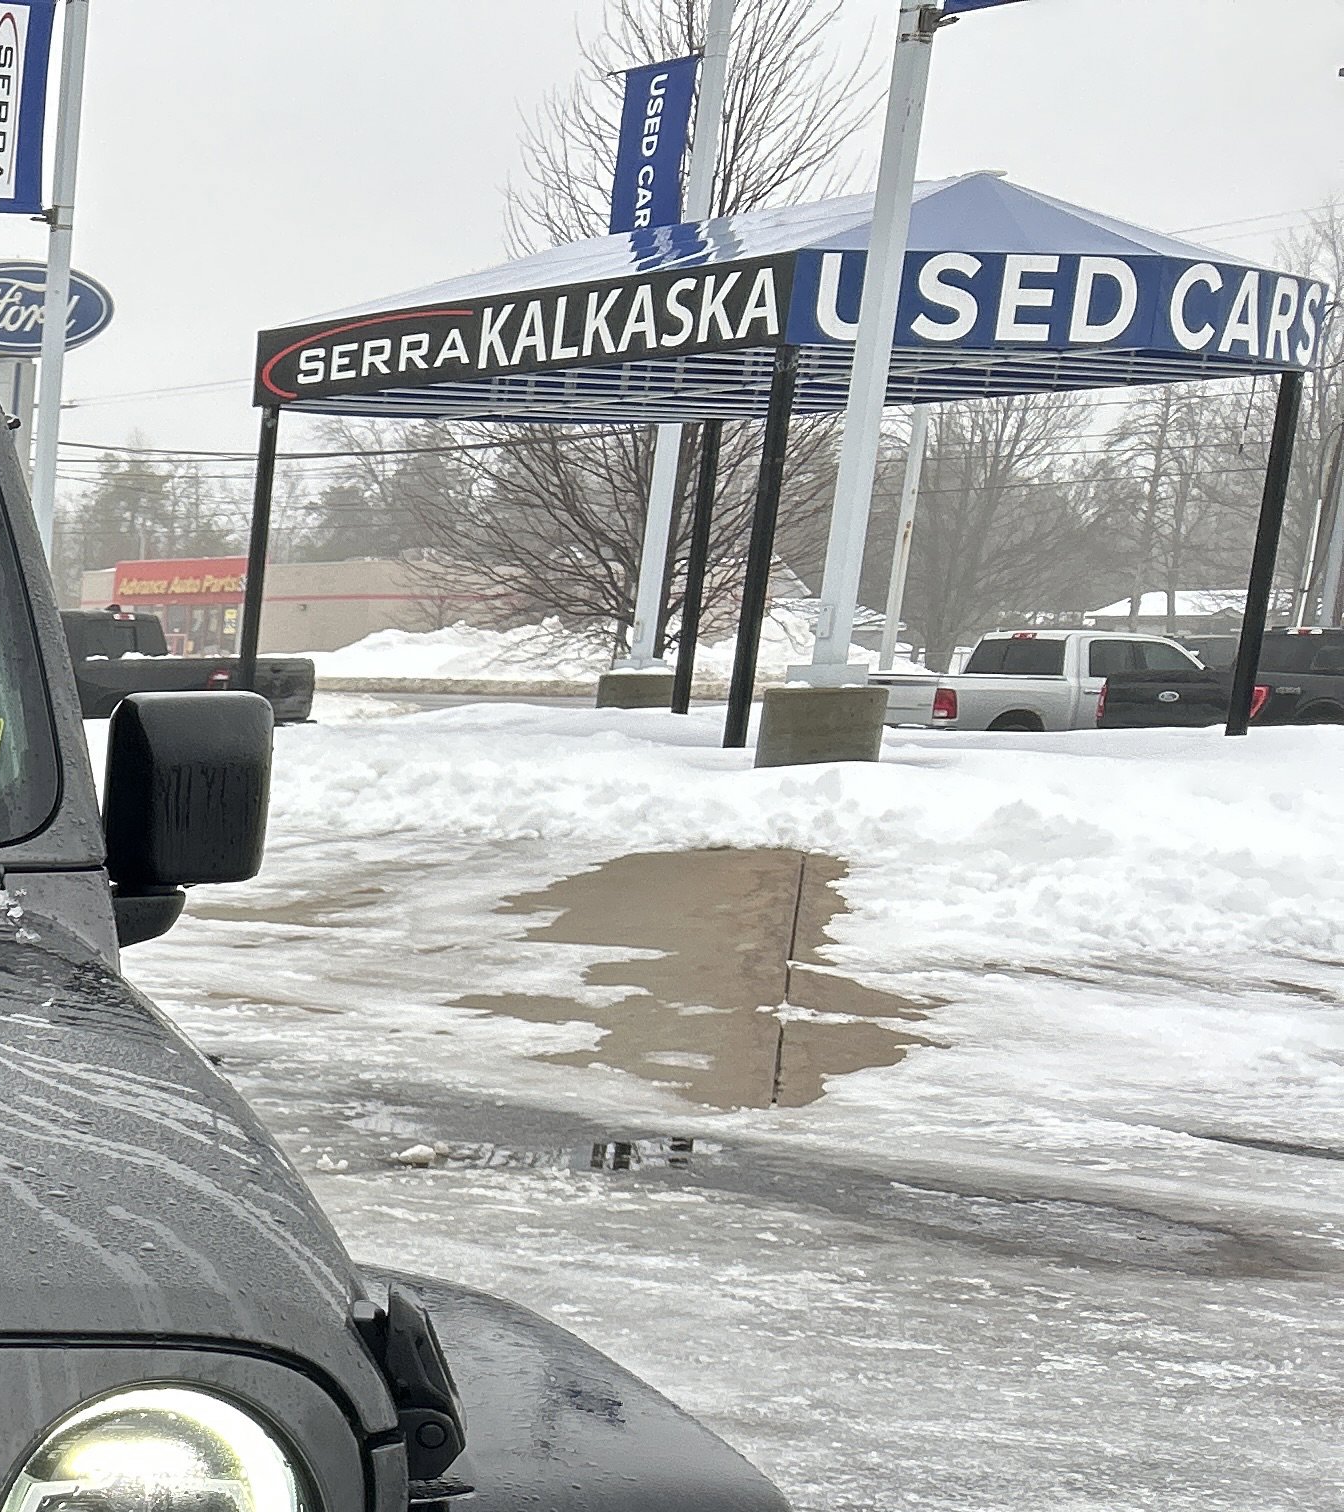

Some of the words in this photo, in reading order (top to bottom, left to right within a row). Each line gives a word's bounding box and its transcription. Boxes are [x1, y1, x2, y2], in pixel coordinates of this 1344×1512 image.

[641, 73, 669, 158] USED
[296, 327, 472, 386] SERRA
[477, 267, 780, 370] KALKASKA
[815, 252, 1139, 343] USED
[1169, 262, 1322, 367] CARS
[119, 577, 168, 595] Advance
[168, 576, 201, 594] Auto
[202, 574, 242, 592] Parts
